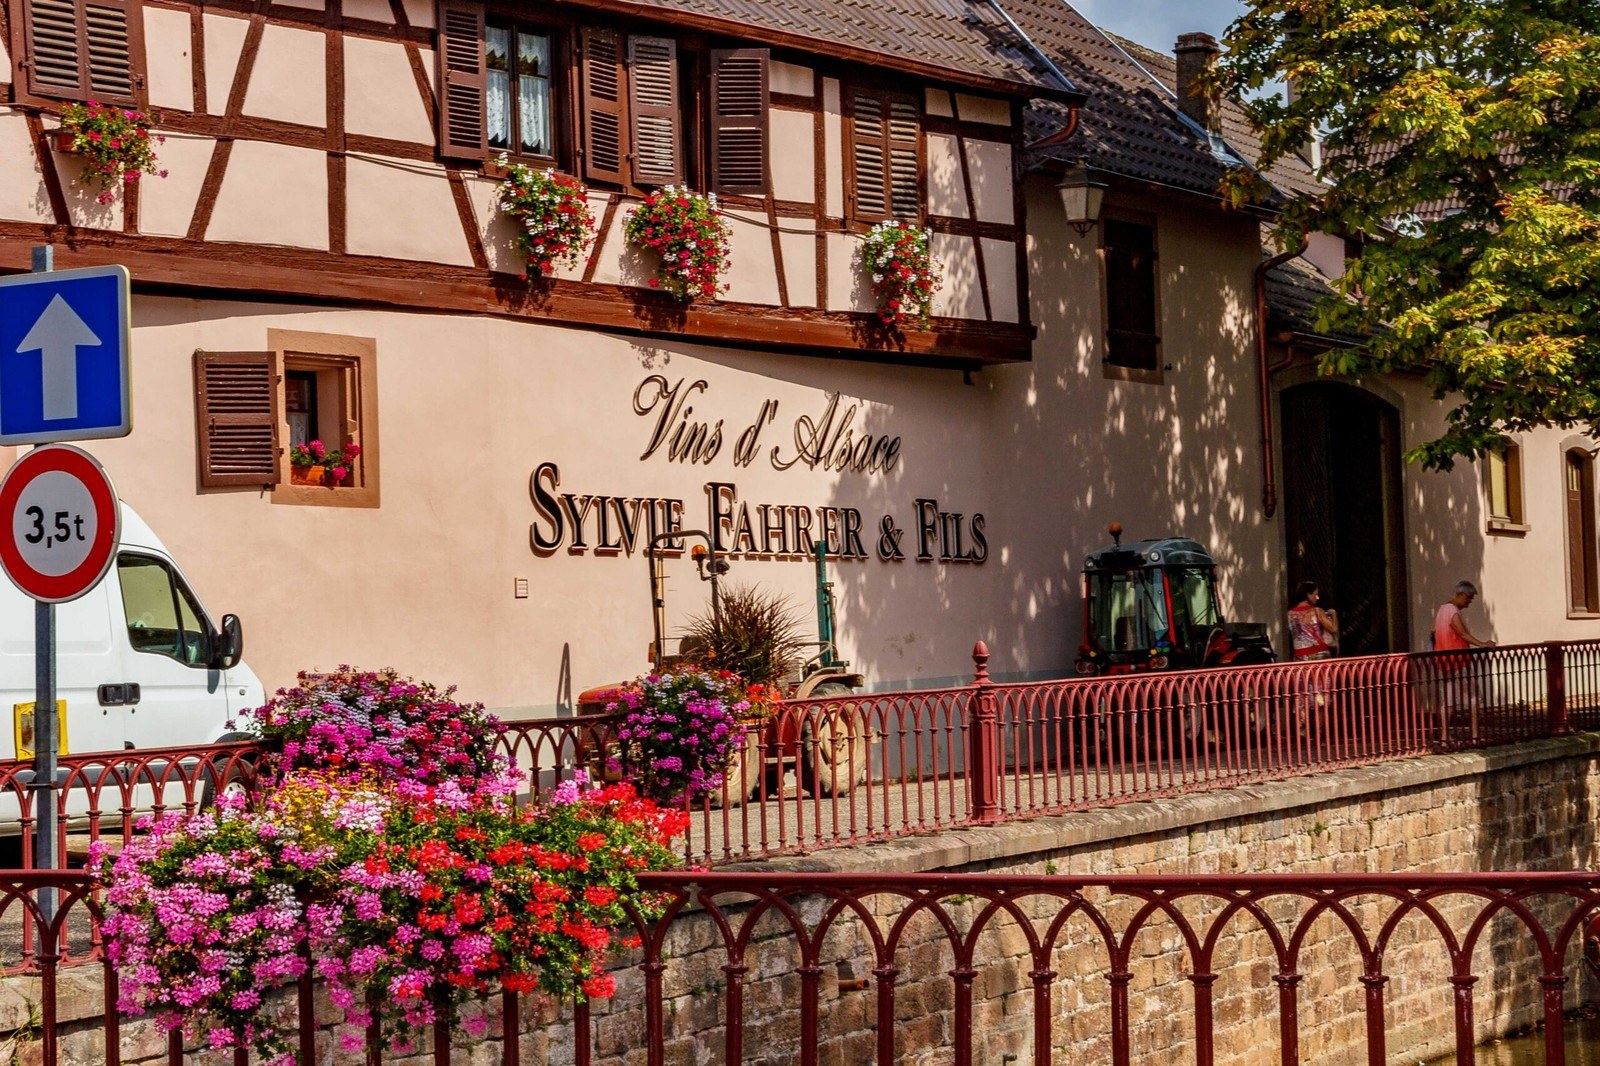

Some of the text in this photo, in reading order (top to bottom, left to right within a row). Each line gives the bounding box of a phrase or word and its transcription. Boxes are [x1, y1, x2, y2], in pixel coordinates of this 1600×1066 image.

[633, 374, 723, 465] Vins
[771, 391, 902, 475] Alsace
[878, 514, 905, 562] &
